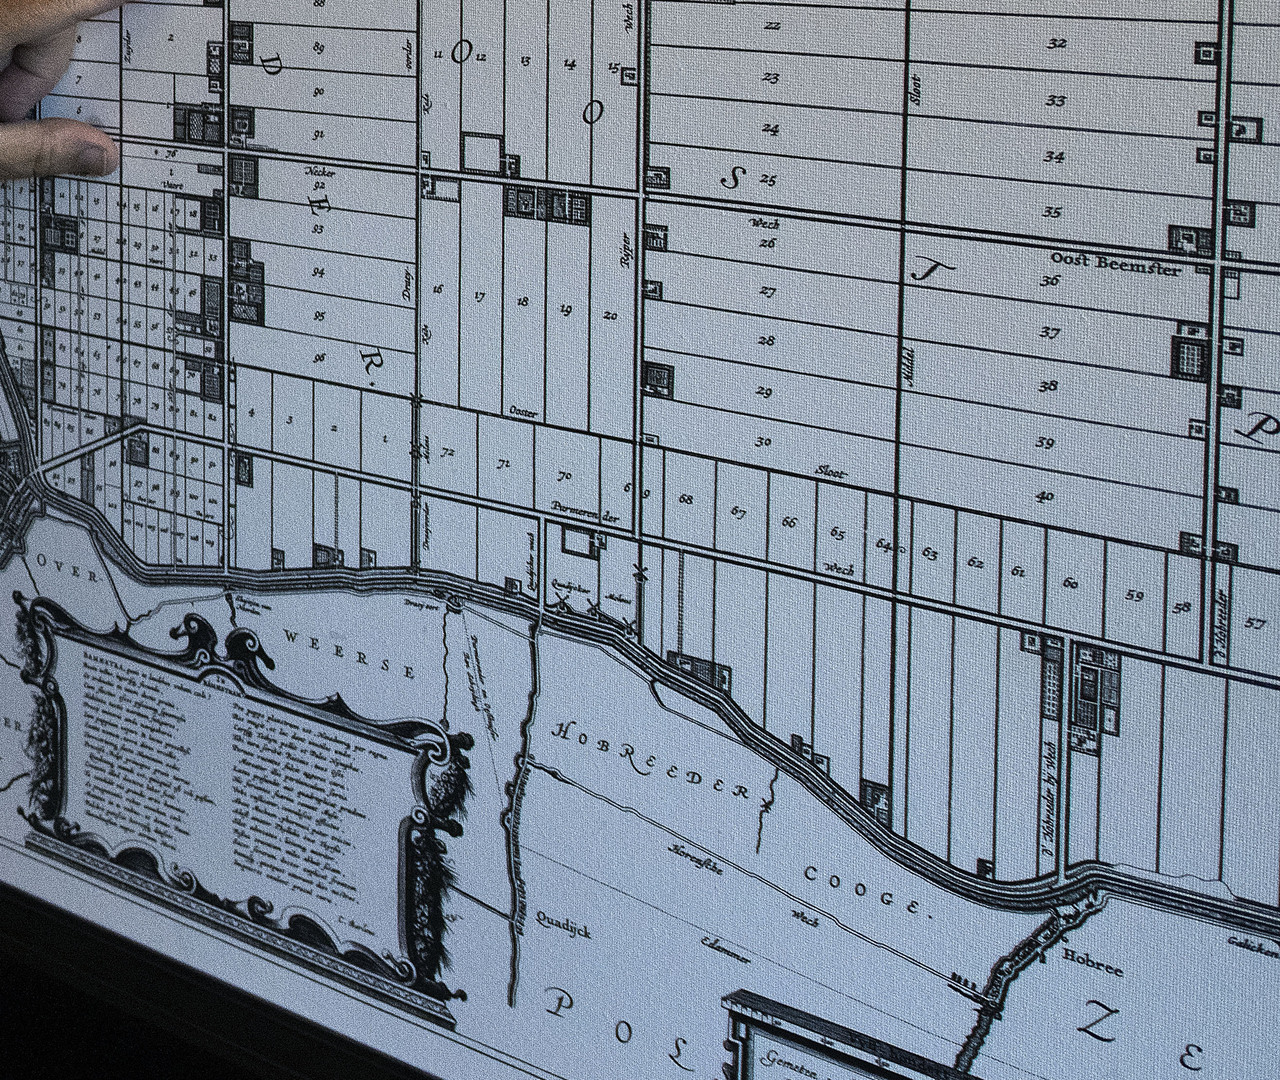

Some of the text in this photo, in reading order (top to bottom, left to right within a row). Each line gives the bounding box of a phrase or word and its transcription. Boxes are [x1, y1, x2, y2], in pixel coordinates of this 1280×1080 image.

[764, 20, 781, 31] 22
[434, 51, 443, 59] 11
[521, 56, 531, 66] 13
[608, 63, 620, 73] 15
[762, 72, 780, 84] 23
[314, 87, 325, 97] 90
[762, 122, 780, 136] 24
[760, 173, 777, 187] 25
[312, 223, 324, 234] 93
[759, 235, 776, 249] 26
[1050, 252, 1089, 269] Oost
[313, 267, 325, 278] 94
[433, 285, 443, 294] 16
[759, 284, 776, 298] 27
[518, 296, 529, 307] 18
[314, 311, 325, 322] 95
[604, 311, 617, 320] 20
[758, 334, 775, 347] 28
[756, 385, 773, 398] 29
[1039, 380, 1058, 393] 38
[510, 405, 538, 418] Ooster
[1035, 436, 1055, 451] 39
[497, 459, 510, 469] 71
[1036, 490, 1054, 504] 40
[731, 505, 746, 520] 67
[831, 526, 846, 542] 65
[968, 556, 984, 570] 62
[1063, 576, 1078, 590] 60
[1173, 600, 1191, 615] 58
[282, 629, 415, 680] WEERSE
[552, 721, 749, 801] HOBREEDER
[1062, 948, 1124, 979] Hobree
